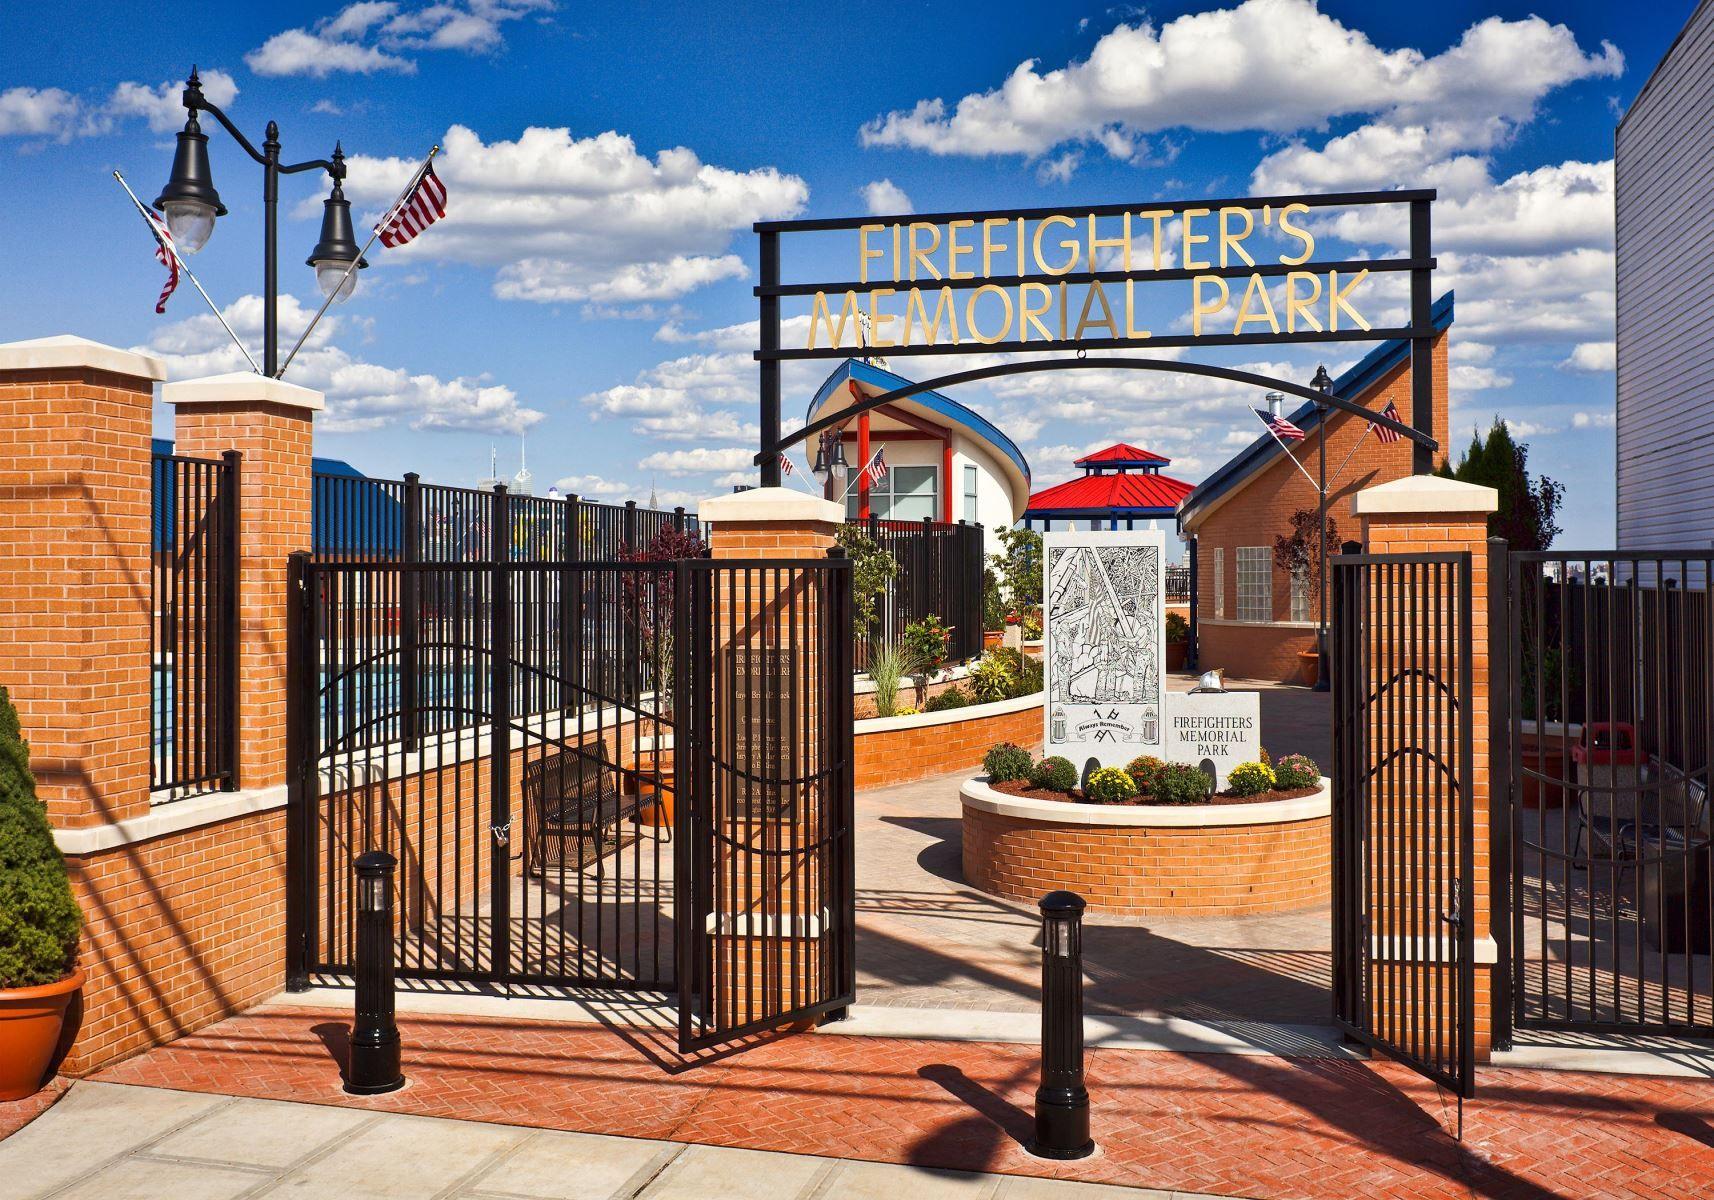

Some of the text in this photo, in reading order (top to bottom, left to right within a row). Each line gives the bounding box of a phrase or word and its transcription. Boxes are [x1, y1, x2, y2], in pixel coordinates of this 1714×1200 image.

[860, 203, 1315, 284] FIREFIGHTER'S
[807, 268, 1372, 351] MEMORIAL PARK
[1078, 722, 1099, 732] Always
[1173, 716, 1253, 729] FIREFIGHTERS
[1179, 730, 1247, 743] MEMORIAL
[1197, 744, 1229, 756] PARK
